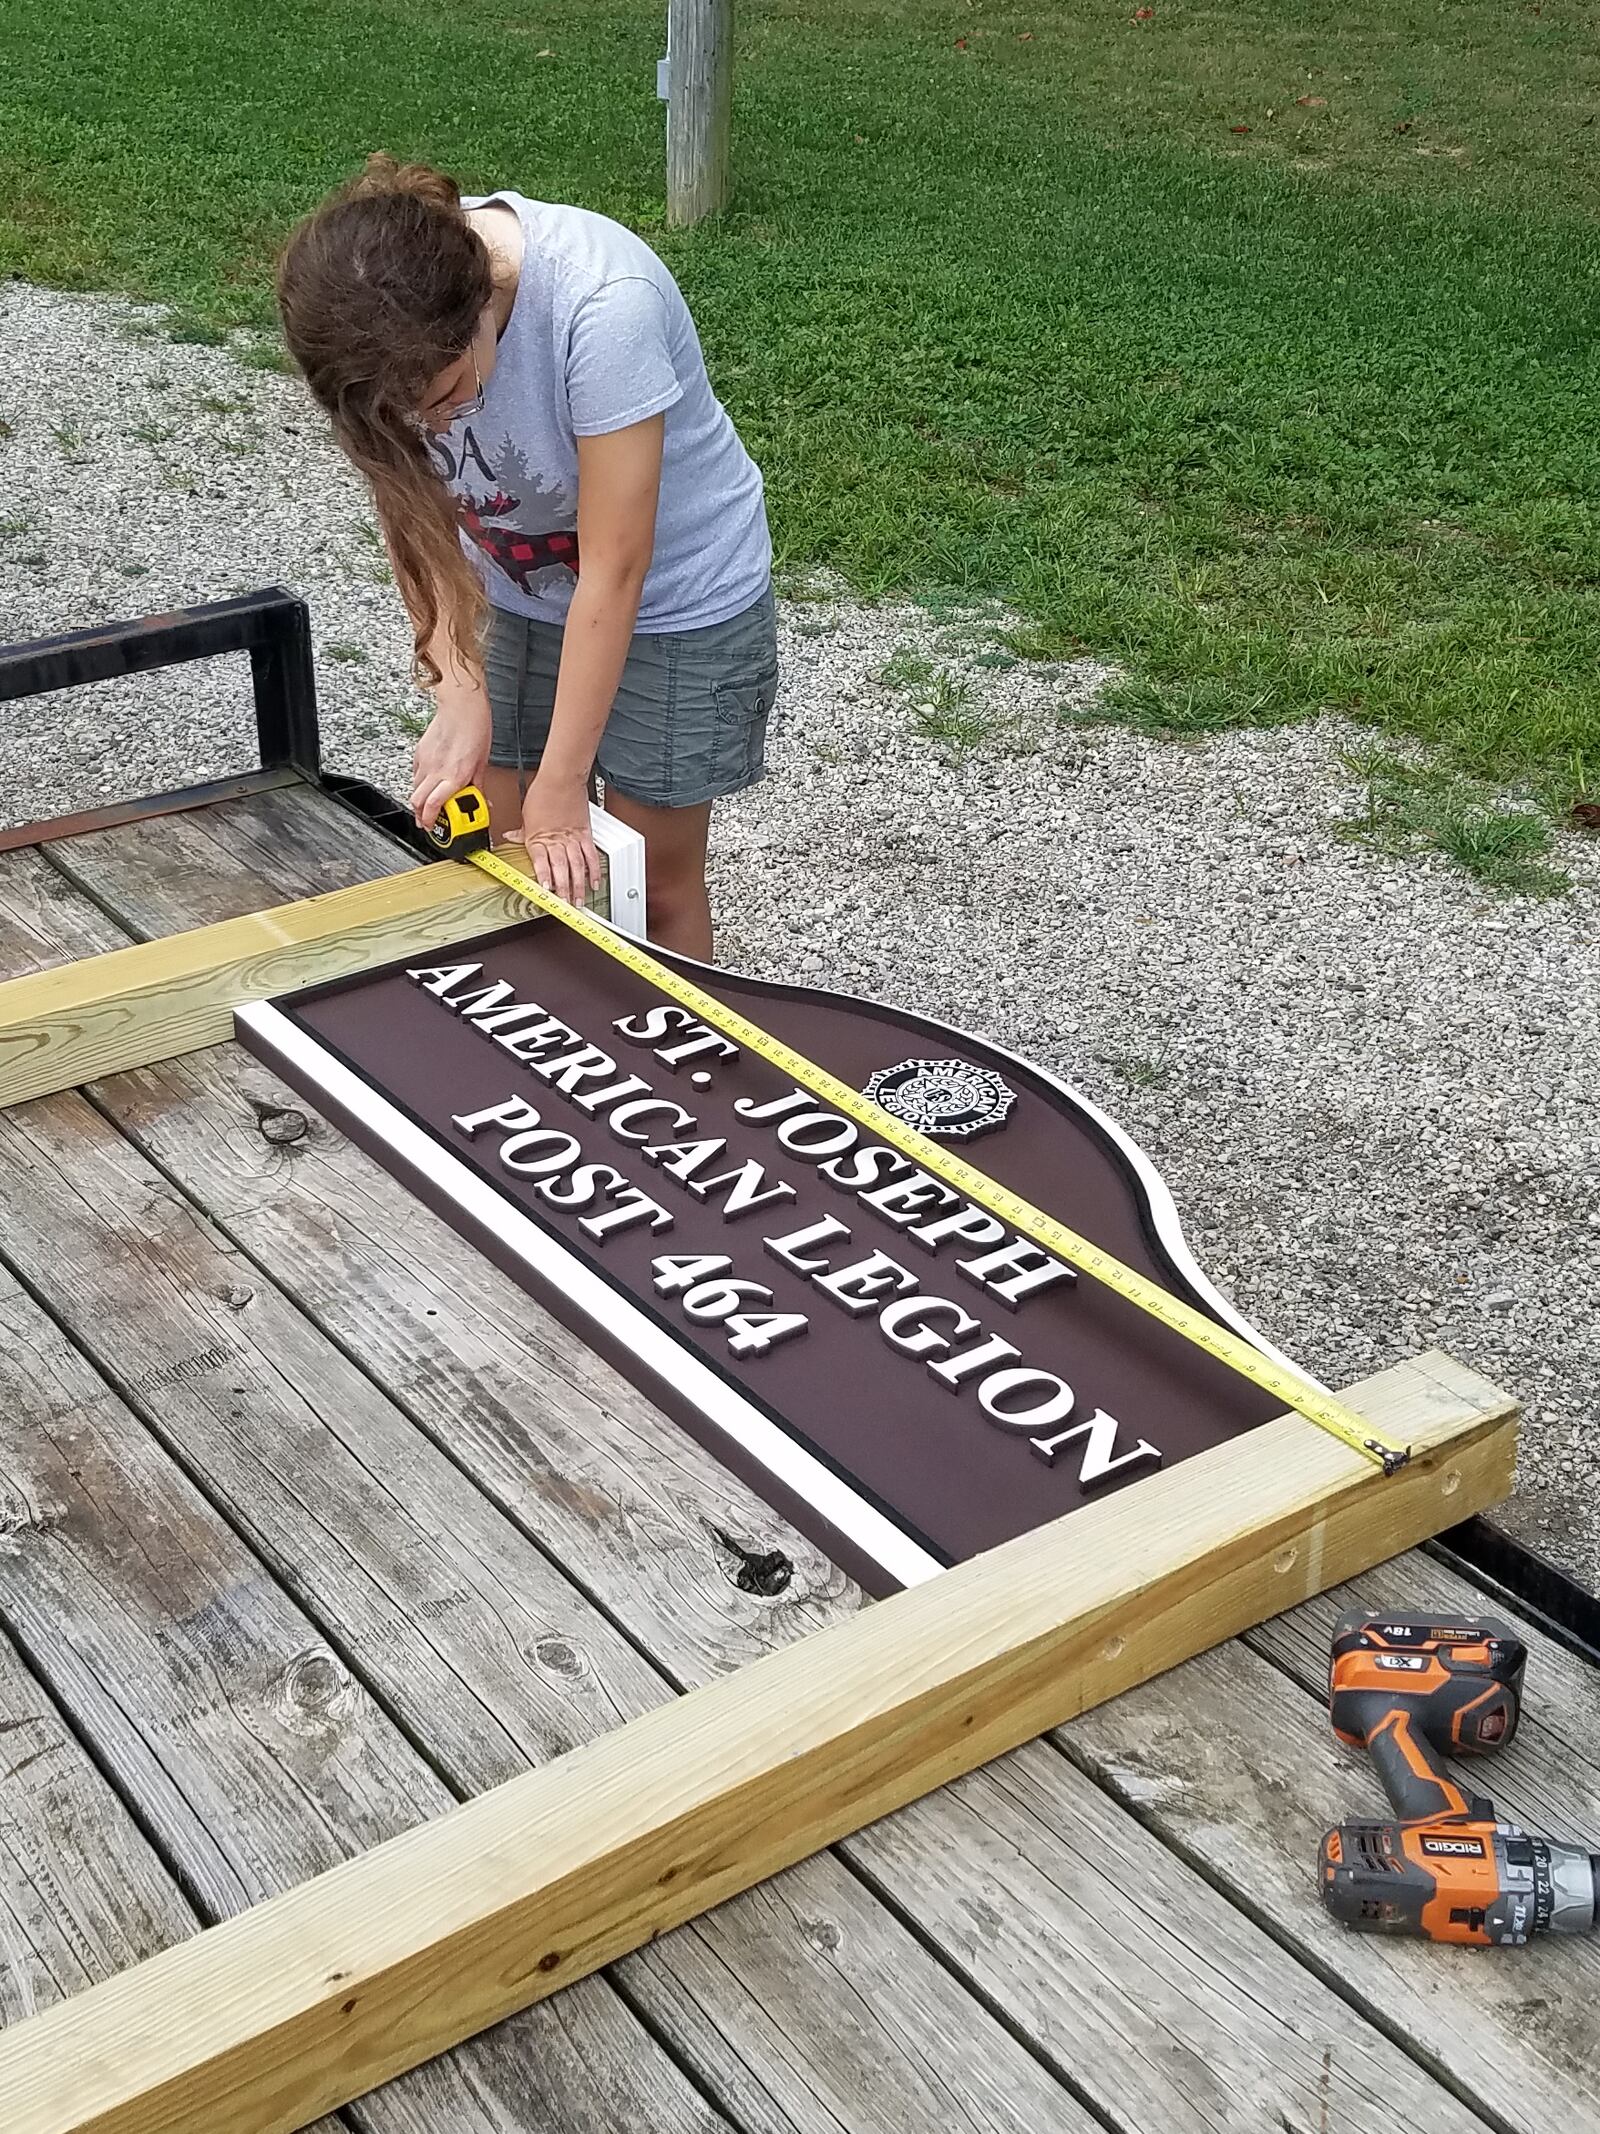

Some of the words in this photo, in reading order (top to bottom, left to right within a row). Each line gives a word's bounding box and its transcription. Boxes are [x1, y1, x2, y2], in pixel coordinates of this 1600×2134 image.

[917, 1067, 998, 1114] AMERICAN
[878, 1086, 936, 1125] LEGION
[868, 1112, 880, 1121] 25
[903, 1134, 915, 1144] 23
[612, 1005, 739, 1086] ST.
[733, 1087, 1078, 1305] JOSEPH
[920, 1145, 932, 1155] 22
[939, 1158, 951, 1167] 21
[956, 1169, 969, 1179] 20
[974, 1181, 985, 1190] 19
[1011, 1206, 1023, 1214] 17
[405, 962, 797, 1216] AMERICAN
[762, 1213, 1163, 1485] LEGION
[451, 1094, 674, 1240] POST
[650, 1253, 809, 1352] 464
[1051, 1230, 1062, 1240] 15
[1112, 1270, 1123, 1280] 12
[1128, 1288, 1141, 1297] 11
[1147, 1301, 1163, 1312] 10
[1246, 1365, 1256, 1373] 6
[1269, 1380, 1281, 1388] 5
[1425, 1840, 1483, 1855] RIDGID
[1535, 1855, 1548, 1868] 20
[1537, 1880, 1550, 1895] 22
[1537, 1906, 1549, 1918] 24
